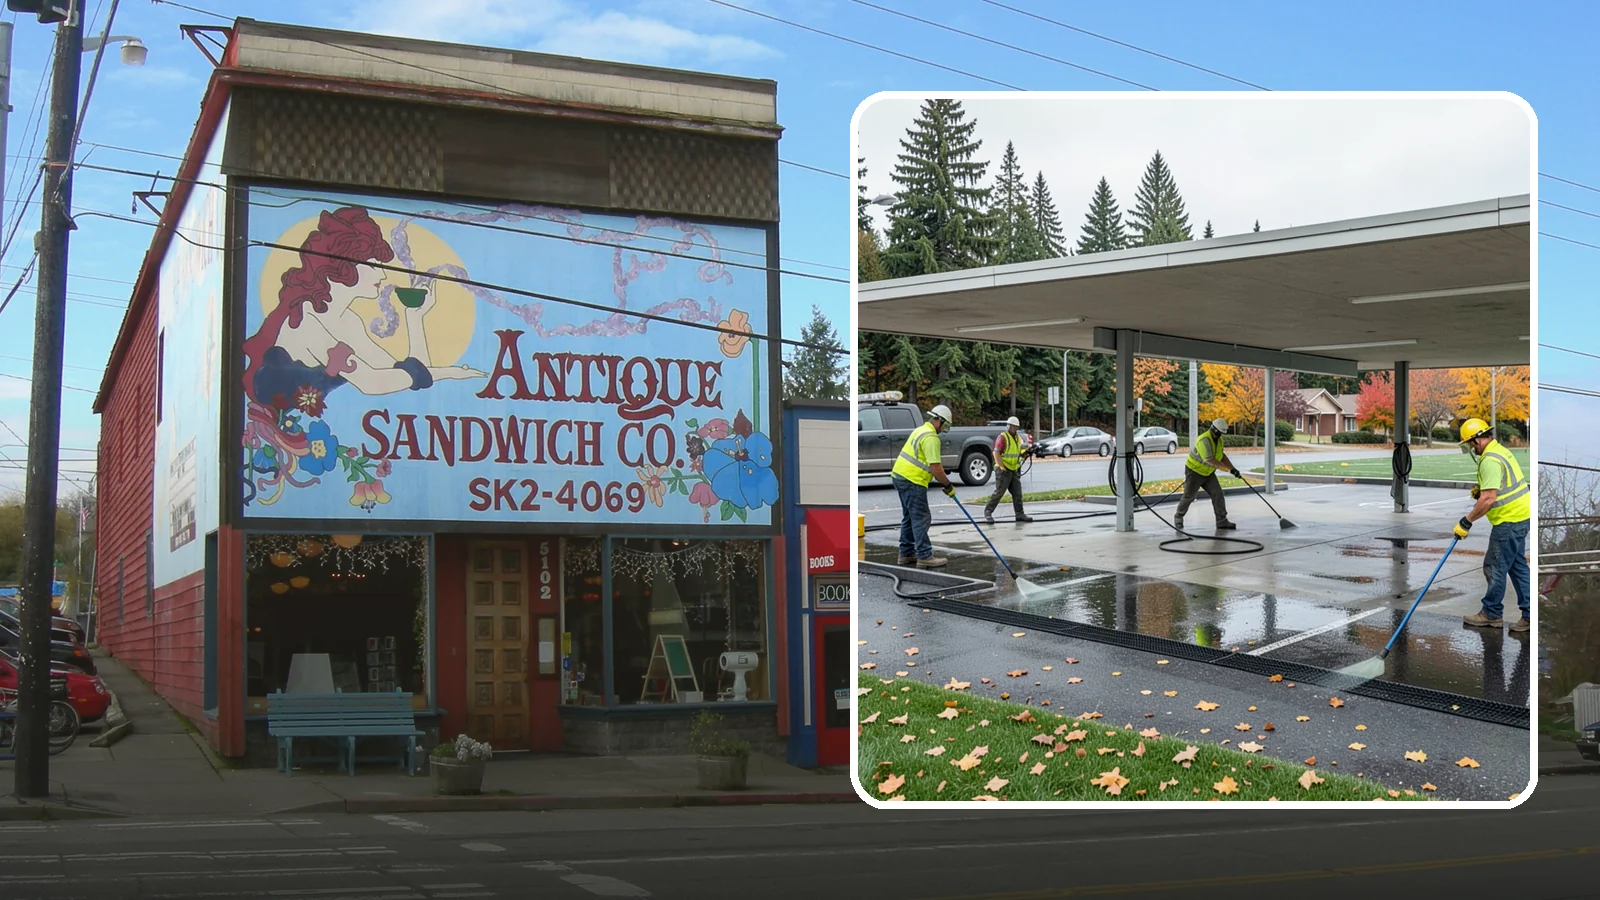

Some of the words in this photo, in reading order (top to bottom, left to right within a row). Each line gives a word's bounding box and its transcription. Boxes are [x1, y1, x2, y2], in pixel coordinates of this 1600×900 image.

[361, 409, 604, 467] SANDWICH
[617, 422, 685, 469] CO.
[468, 477, 646, 513] SK2-4069
[539, 541, 552, 600] 5102
[809, 555, 835, 569] BOOKS
